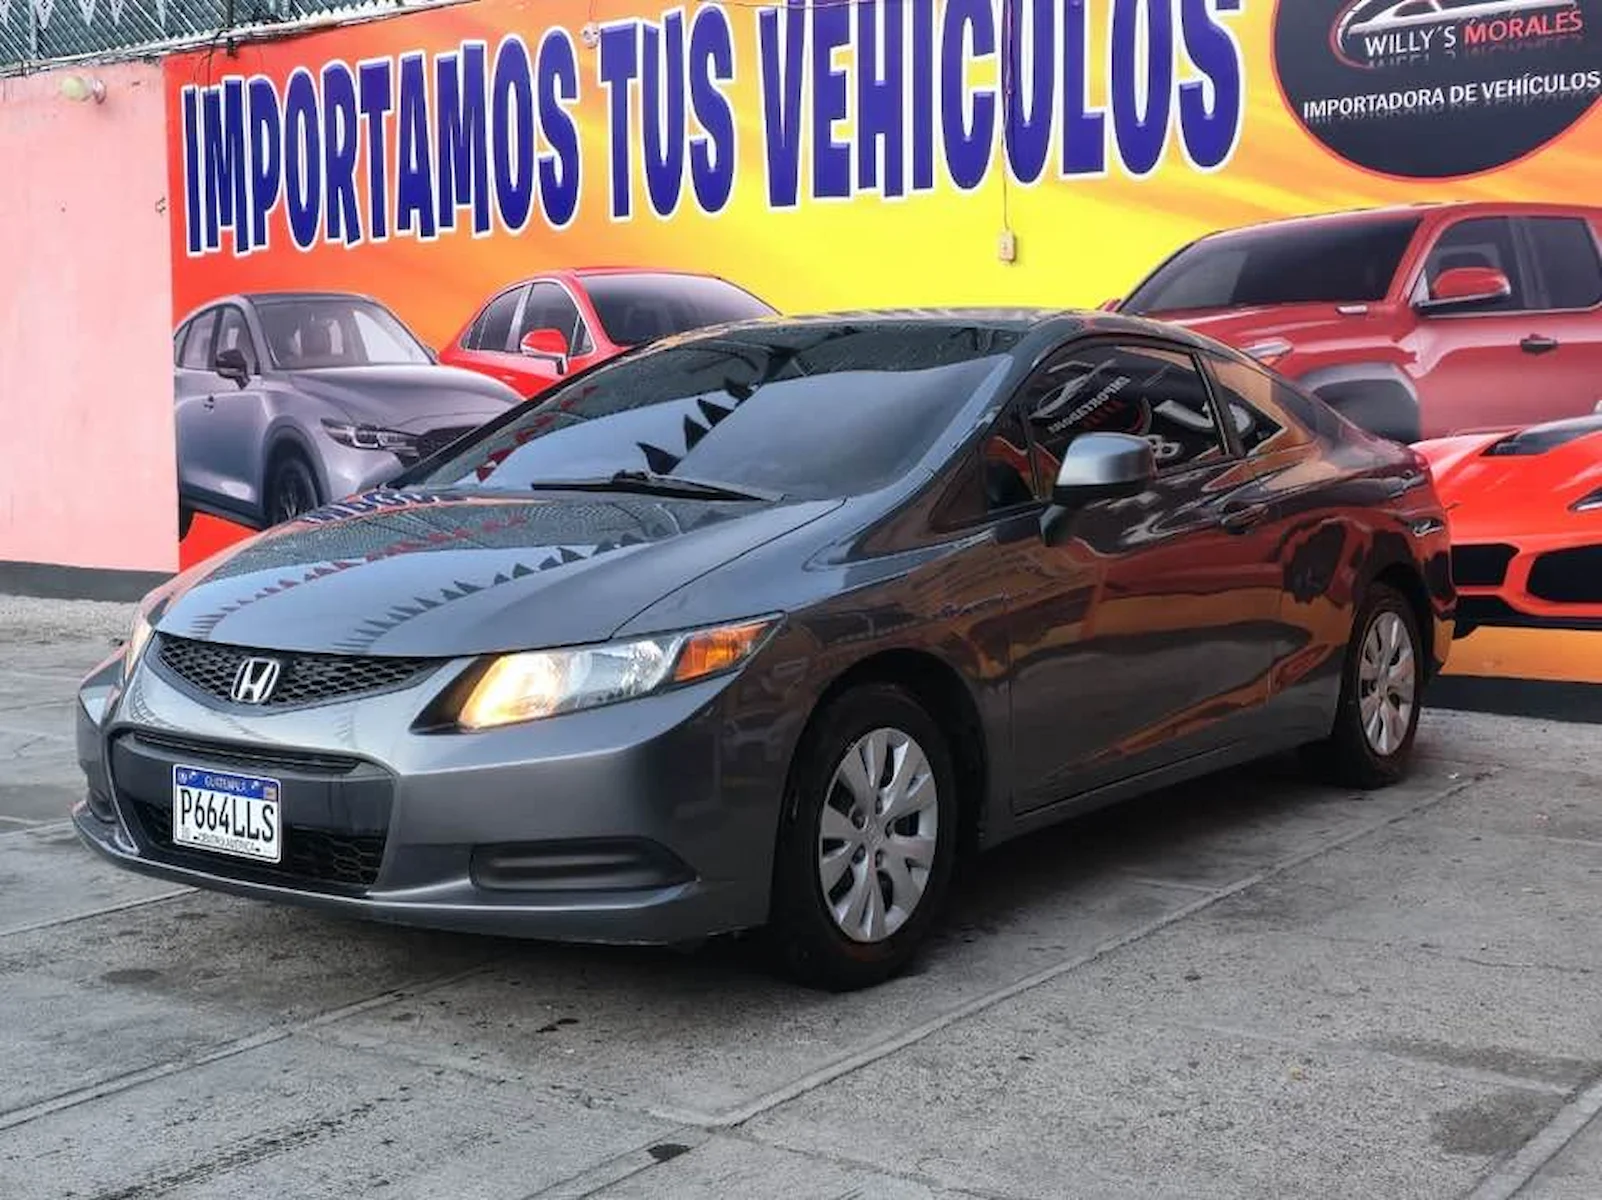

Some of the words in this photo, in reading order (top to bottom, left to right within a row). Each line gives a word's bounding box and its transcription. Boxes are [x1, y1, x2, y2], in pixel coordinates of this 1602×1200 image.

[1463, 10, 1583, 45] MORALES
[1303, 88, 1446, 119] IMPORTADORA
[1449, 83, 1477, 102] DE
[1481, 69, 1601, 100] VEHÍCULOS
[183, 26, 582, 256] IMPORTAMOS
[597, 4, 737, 221] TUS
[180, 788, 275, 843] P664LLS
